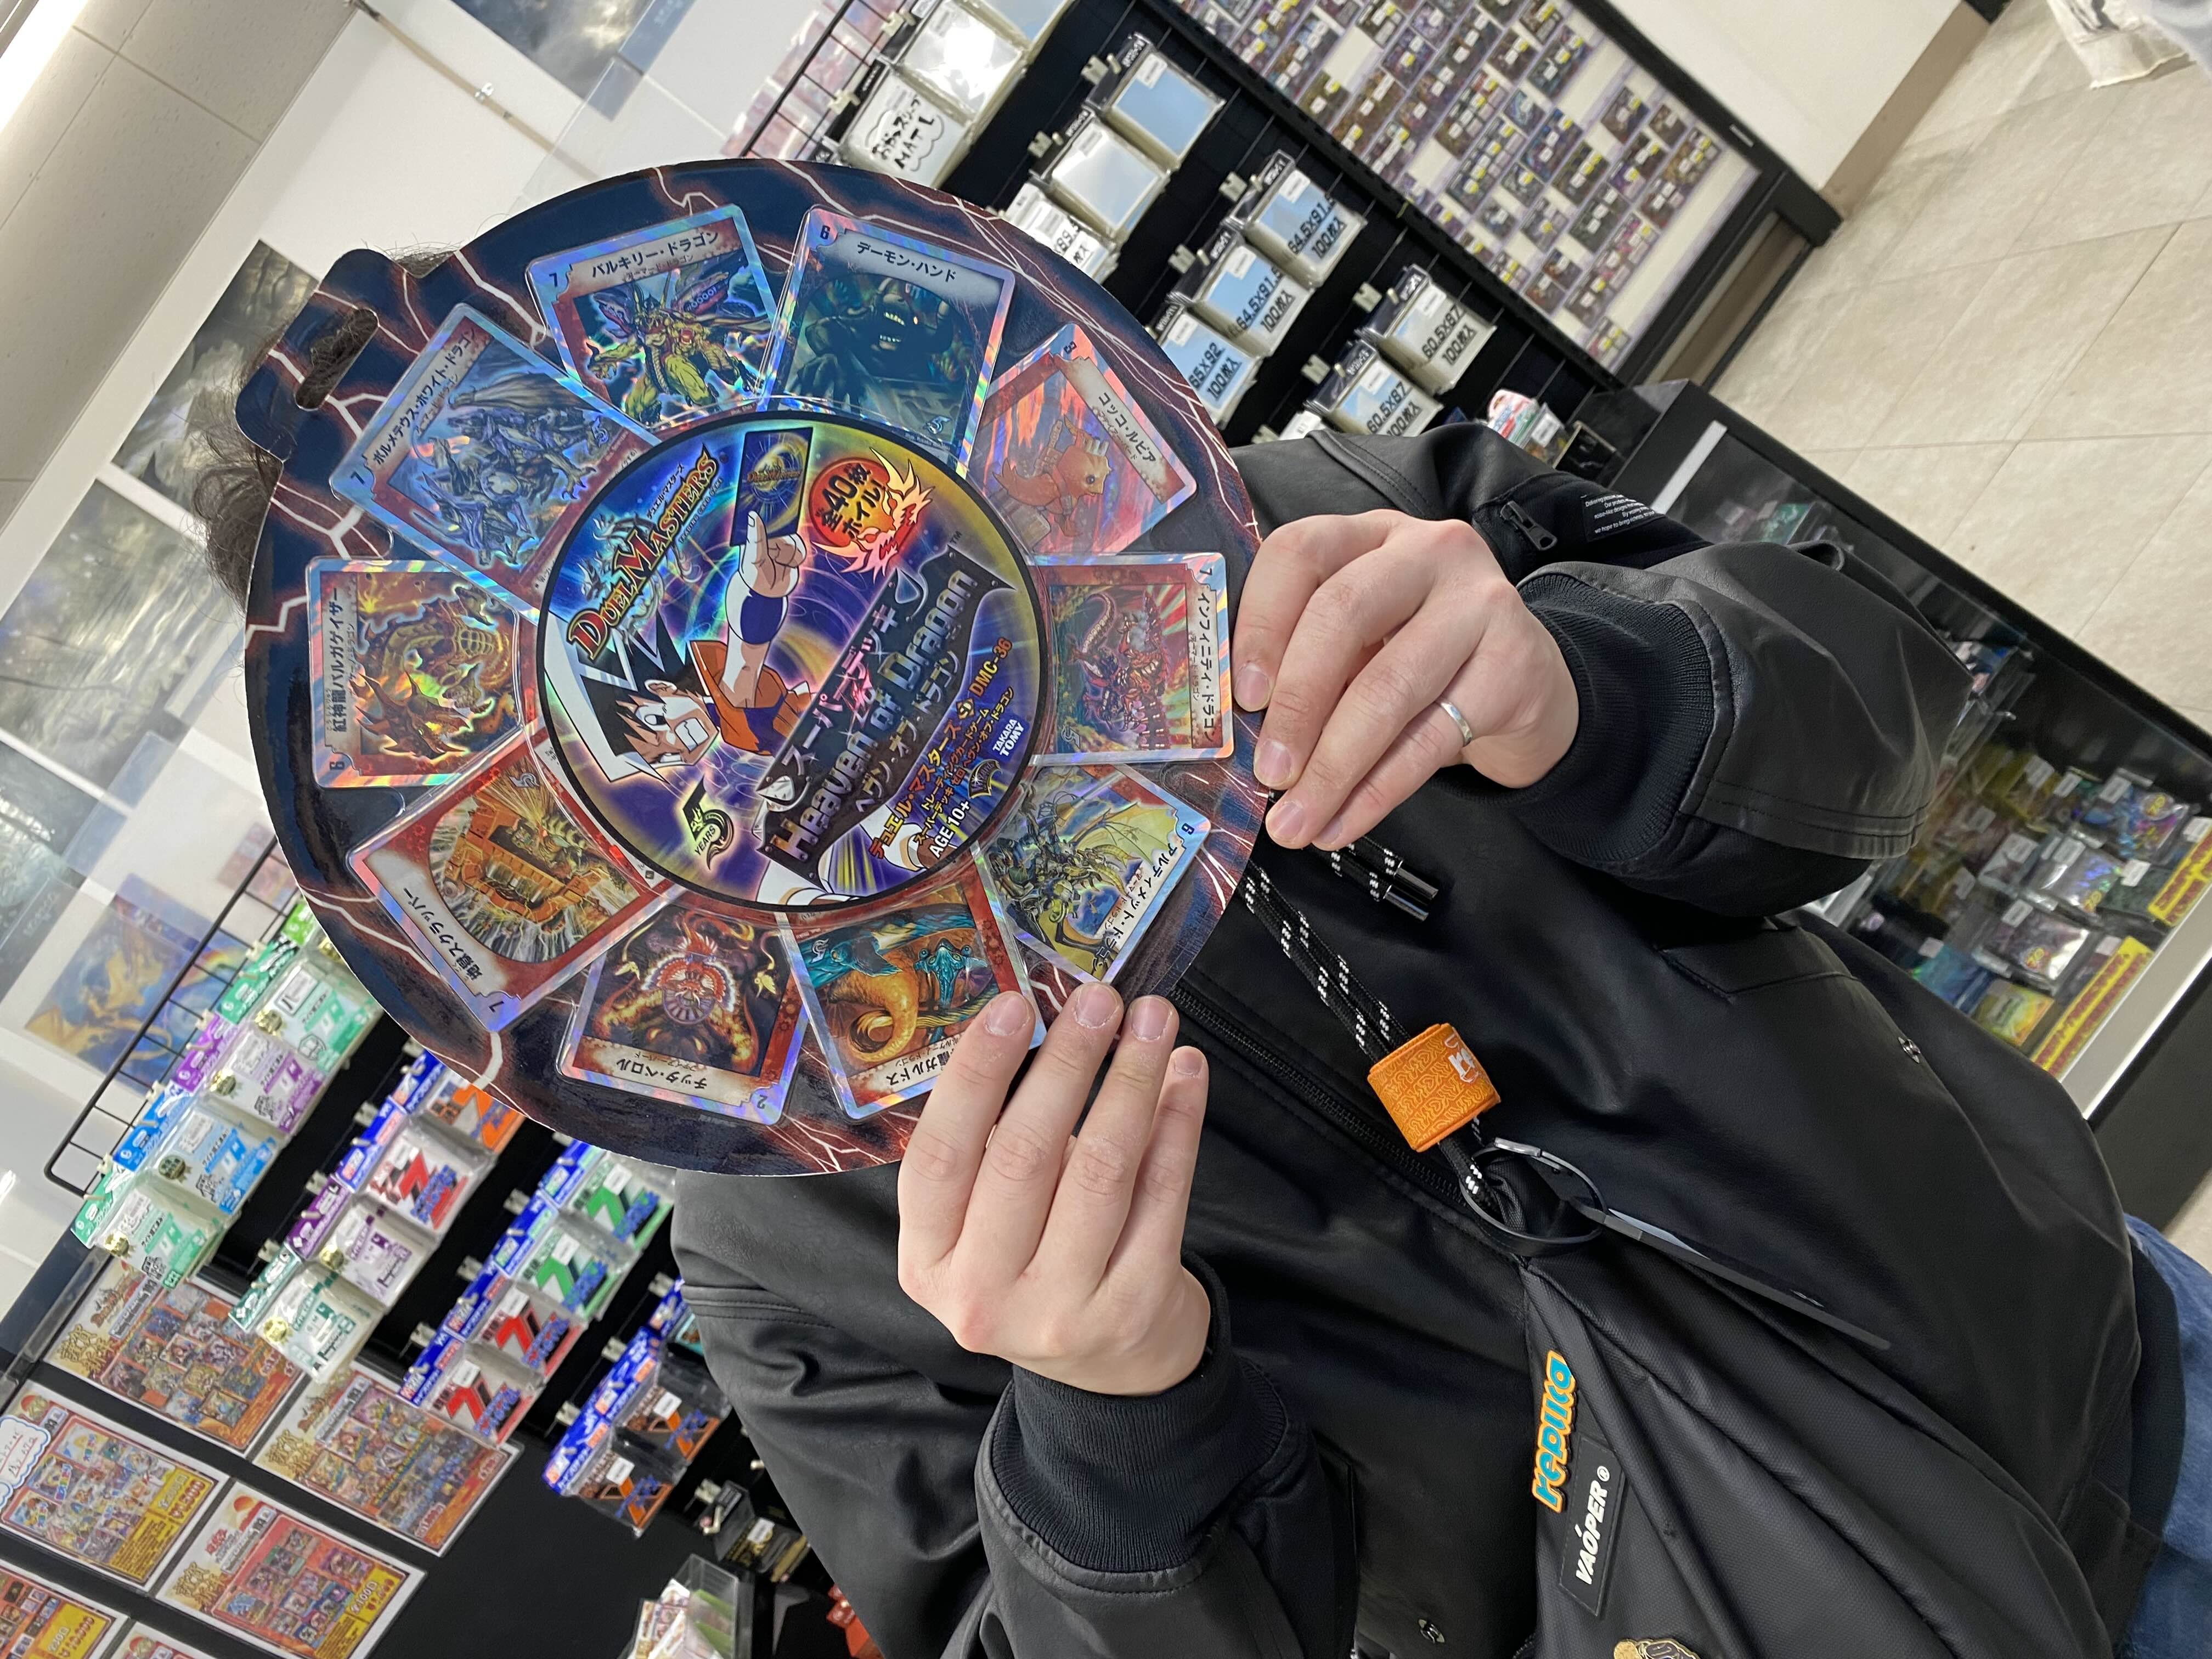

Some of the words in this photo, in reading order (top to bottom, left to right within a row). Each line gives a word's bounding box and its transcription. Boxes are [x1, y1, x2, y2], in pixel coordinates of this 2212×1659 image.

[591, 231, 719, 278] バルキリー・ドラゴン
[820, 225, 832, 239] 6
[549, 273, 560, 287] 7
[857, 241, 956, 282] デーモン・ハンド
[1064, 341, 1077, 354] 3
[373, 328, 476, 465] ボルメテウス・ホワイト・ドラゴン
[1098, 392, 1156, 462] コッコ・ルピア
[351, 471, 365, 486] 7
[647, 462, 685, 520] デュエル・マスターズ
[822, 462, 871, 533] 全40枚
[1199, 567, 1214, 576] 7
[330, 586, 347, 732] 紅神龍バルガゲイザー
[1197, 591, 1215, 742] インフィニティ・ドラゴン
[769, 731, 879, 861] Heaven
[878, 569, 979, 691] Dragon
[782, 604, 898, 776] スーパーデッキ
[855, 650, 960, 814] ヘヴン・オブ・ドラゴン
[868, 719, 962, 859] デュエル・マスターズ
[968, 636, 1013, 697] DMC-36
[921, 708, 990, 811] トレーディングカードゲーム
[992, 719, 1018, 752] TAKARA
[998, 721, 1025, 757] TOMY
[913, 787, 955, 845] スーパーデッキ
[950, 766, 967, 786] ゼロ
[962, 686, 1014, 768] ヘヴン・オブ・ドラゴン
[694, 825, 716, 855] YEARS
[929, 827, 953, 859] AGE
[947, 800, 970, 830] 10+
[1182, 823, 1195, 835] 6
[402, 887, 483, 981] 地獄スクラッパー
[1091, 843, 1177, 975] アルティメット・ドラゴン
[489, 1000, 505, 1013] 7
[616, 1057, 707, 1090] チッタ・ペロル
[756, 1094, 768, 1109] 2
[1575, 1480, 1609, 1585] VAÓPER
